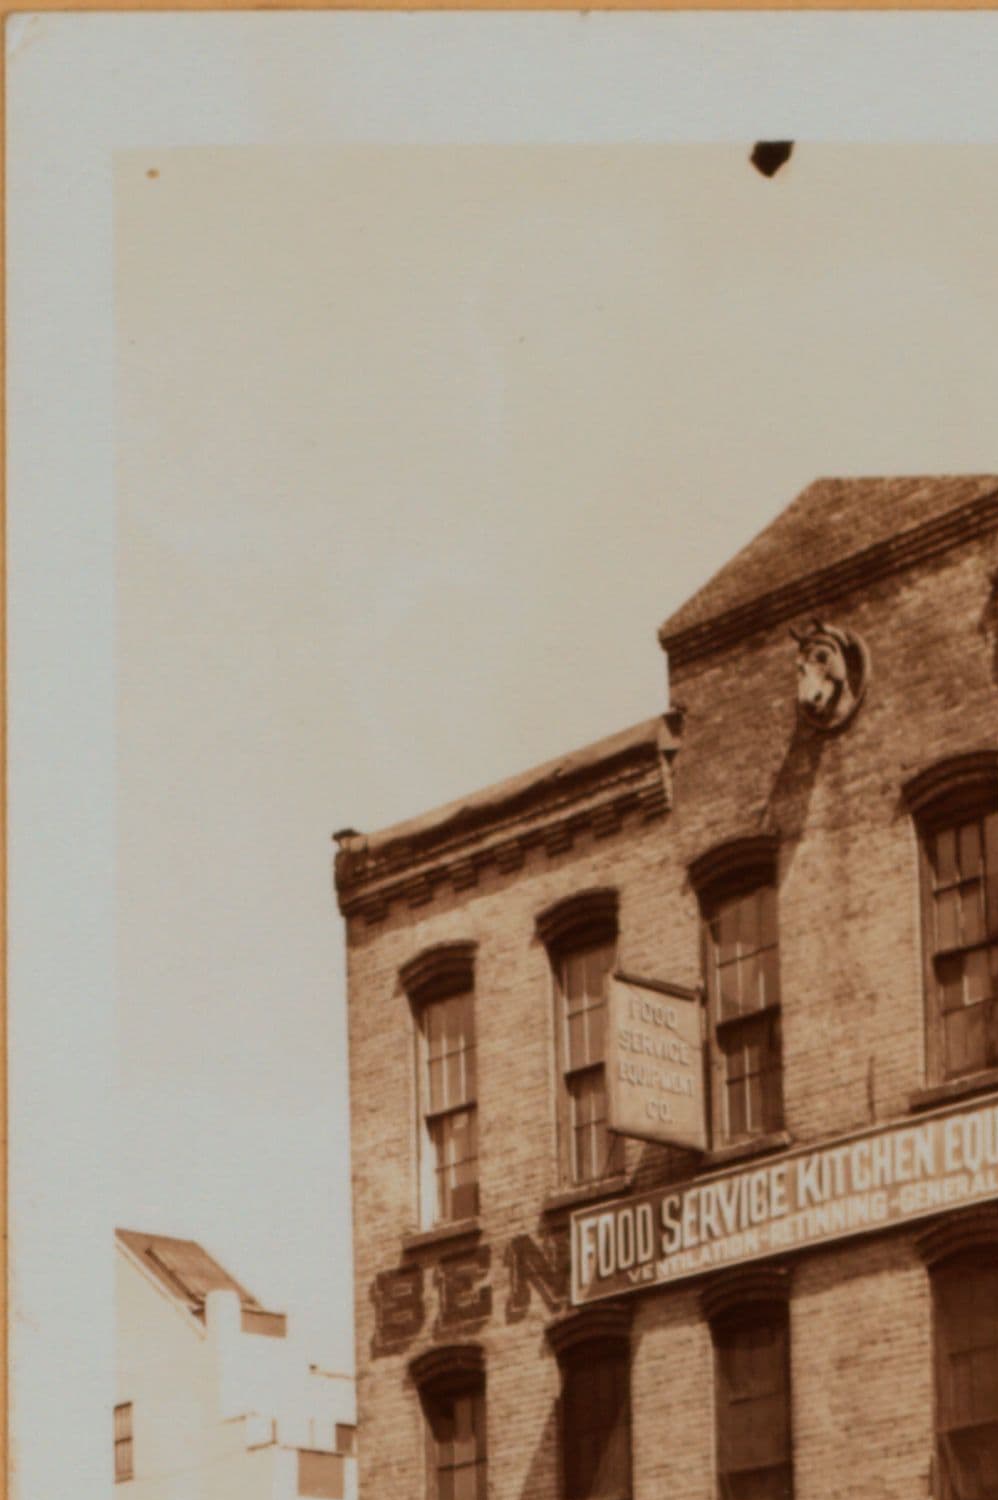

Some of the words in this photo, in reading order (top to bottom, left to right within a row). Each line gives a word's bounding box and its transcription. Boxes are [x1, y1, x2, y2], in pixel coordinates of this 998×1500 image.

[628, 999, 677, 1031] FOOD
[617, 1030, 691, 1067] SERVICE
[616, 1062, 695, 1098] EQUIPMENT
[578, 1203, 653, 1287] FOOD
[661, 1160, 789, 1255] SERVICE
[796, 1121, 936, 1207] KITCHEN
